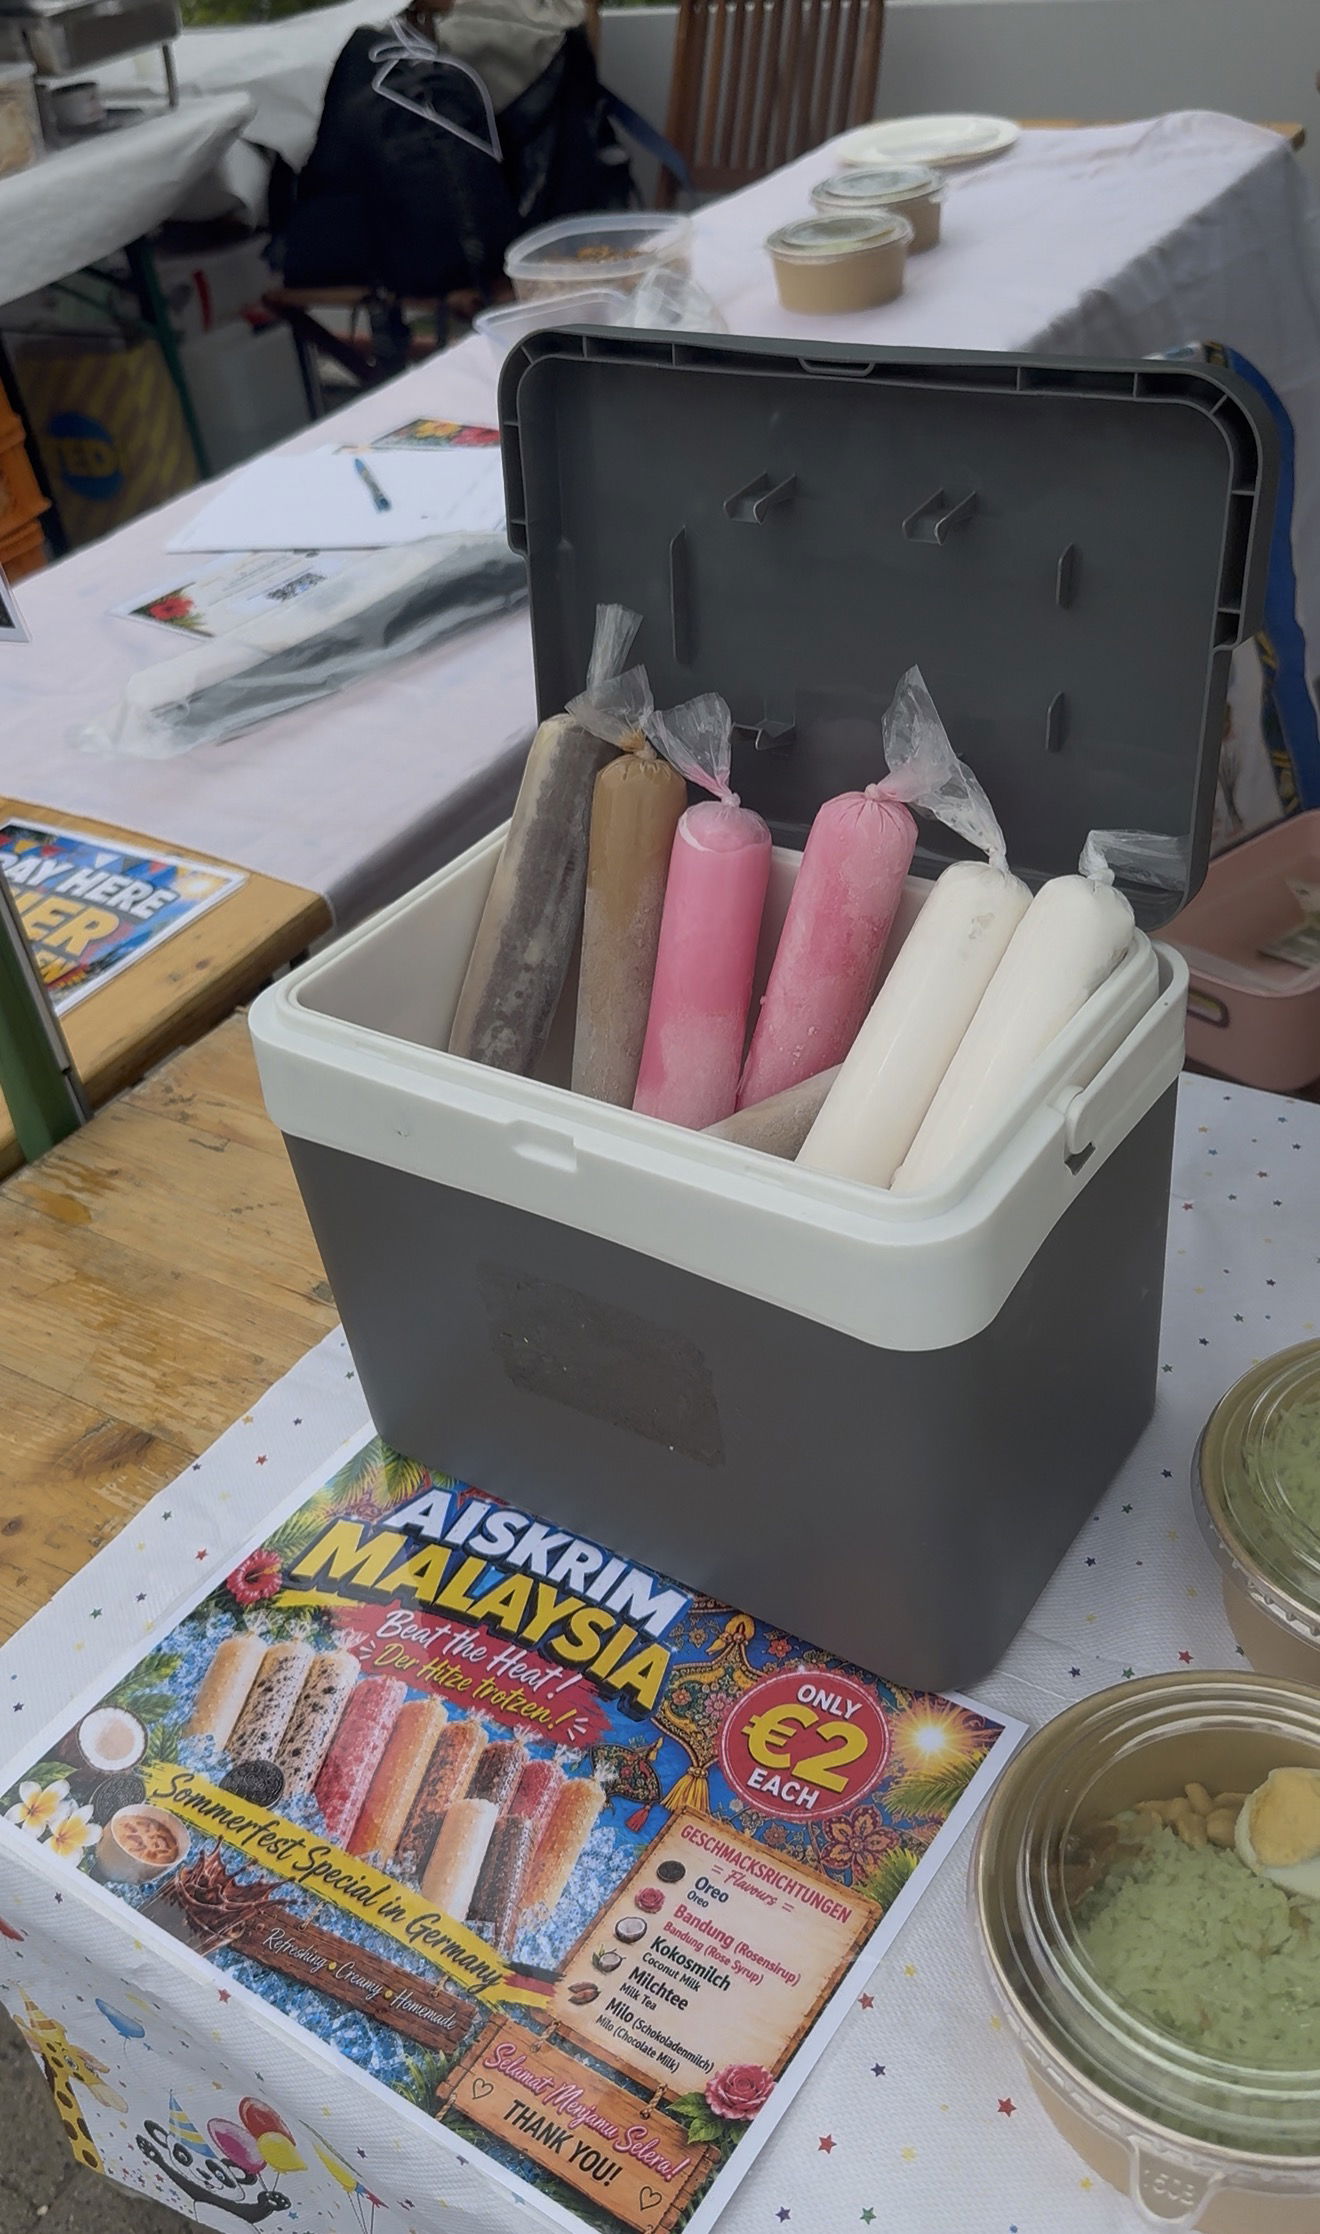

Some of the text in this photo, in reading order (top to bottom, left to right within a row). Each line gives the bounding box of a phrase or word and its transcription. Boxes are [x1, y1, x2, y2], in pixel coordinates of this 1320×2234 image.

[55, 867, 180, 919] HERE
[383, 1488, 690, 1637] AISKRIM
[291, 1519, 672, 1710] MALAYSIA
[376, 1609, 450, 1650] Beat
[442, 1623, 488, 1663] the
[374, 1642, 420, 1670] Der
[416, 1656, 474, 1693] Hitze
[797, 1684, 863, 1721] ONLY
[741, 1703, 869, 1793] €2
[747, 1767, 820, 1810] EACH
[152, 1772, 503, 1995] Sommerfest Special in Germany
[680, 1824, 853, 1924] GESCHMACKSRICHTUNGEN
[686, 1890, 710, 1909] Oreo
[694, 1876, 730, 1904] Oreo
[723, 1869, 779, 1906] Flavours
[641, 1952, 702, 1993] Coconut Milk
[649, 1935, 732, 1992] Kokosmilch
[663, 1921, 765, 1986] Bandung (Rose Syrup)
[673, 1903, 802, 1988] Bandung (Rosensirup)
[262, 1927, 459, 2031] Refreshing Creamy Homemade
[619, 1982, 658, 2011] Milk Tea
[628, 1966, 690, 2011] Milchtee
[595, 2013, 682, 2075] Milo (Chocolate Milk)
[604, 1996, 716, 2075] Milo (Schokoladenmilch)
[483, 2041, 692, 2184] Selamat Menjamu Selera!
[502, 2098, 624, 2188] THANK YOU!
